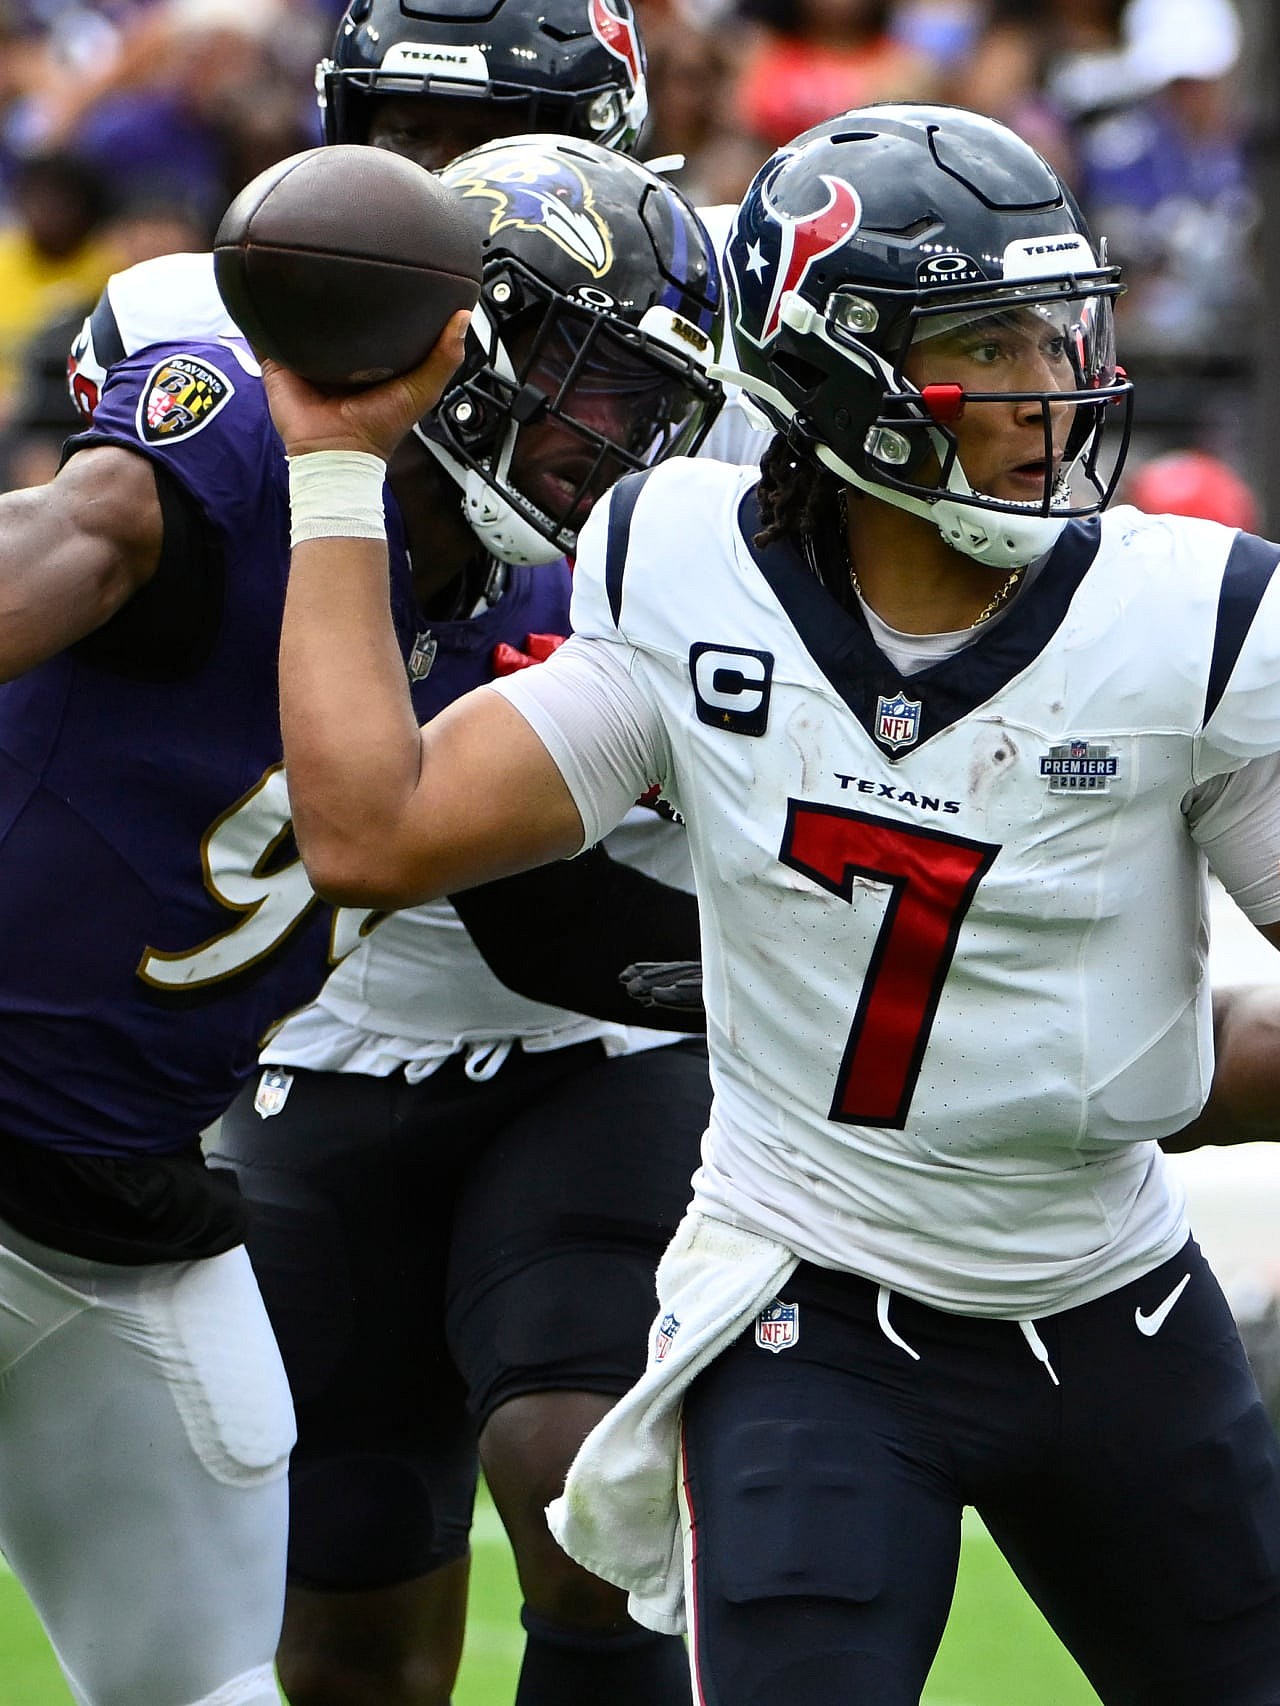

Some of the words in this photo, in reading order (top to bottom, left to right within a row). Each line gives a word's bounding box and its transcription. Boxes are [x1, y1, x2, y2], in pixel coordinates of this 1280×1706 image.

[401, 51, 467, 63] TEXANS
[1023, 241, 1080, 256] TEXANS
[919, 271, 979, 283] OAKLEY
[170, 361, 223, 394] RAVENS
[696, 651, 766, 712] C
[882, 717, 912, 741] NFL
[833, 772, 961, 814] TEXANS
[778, 797, 1001, 1130] 7
[761, 1323, 792, 1344] NFL
